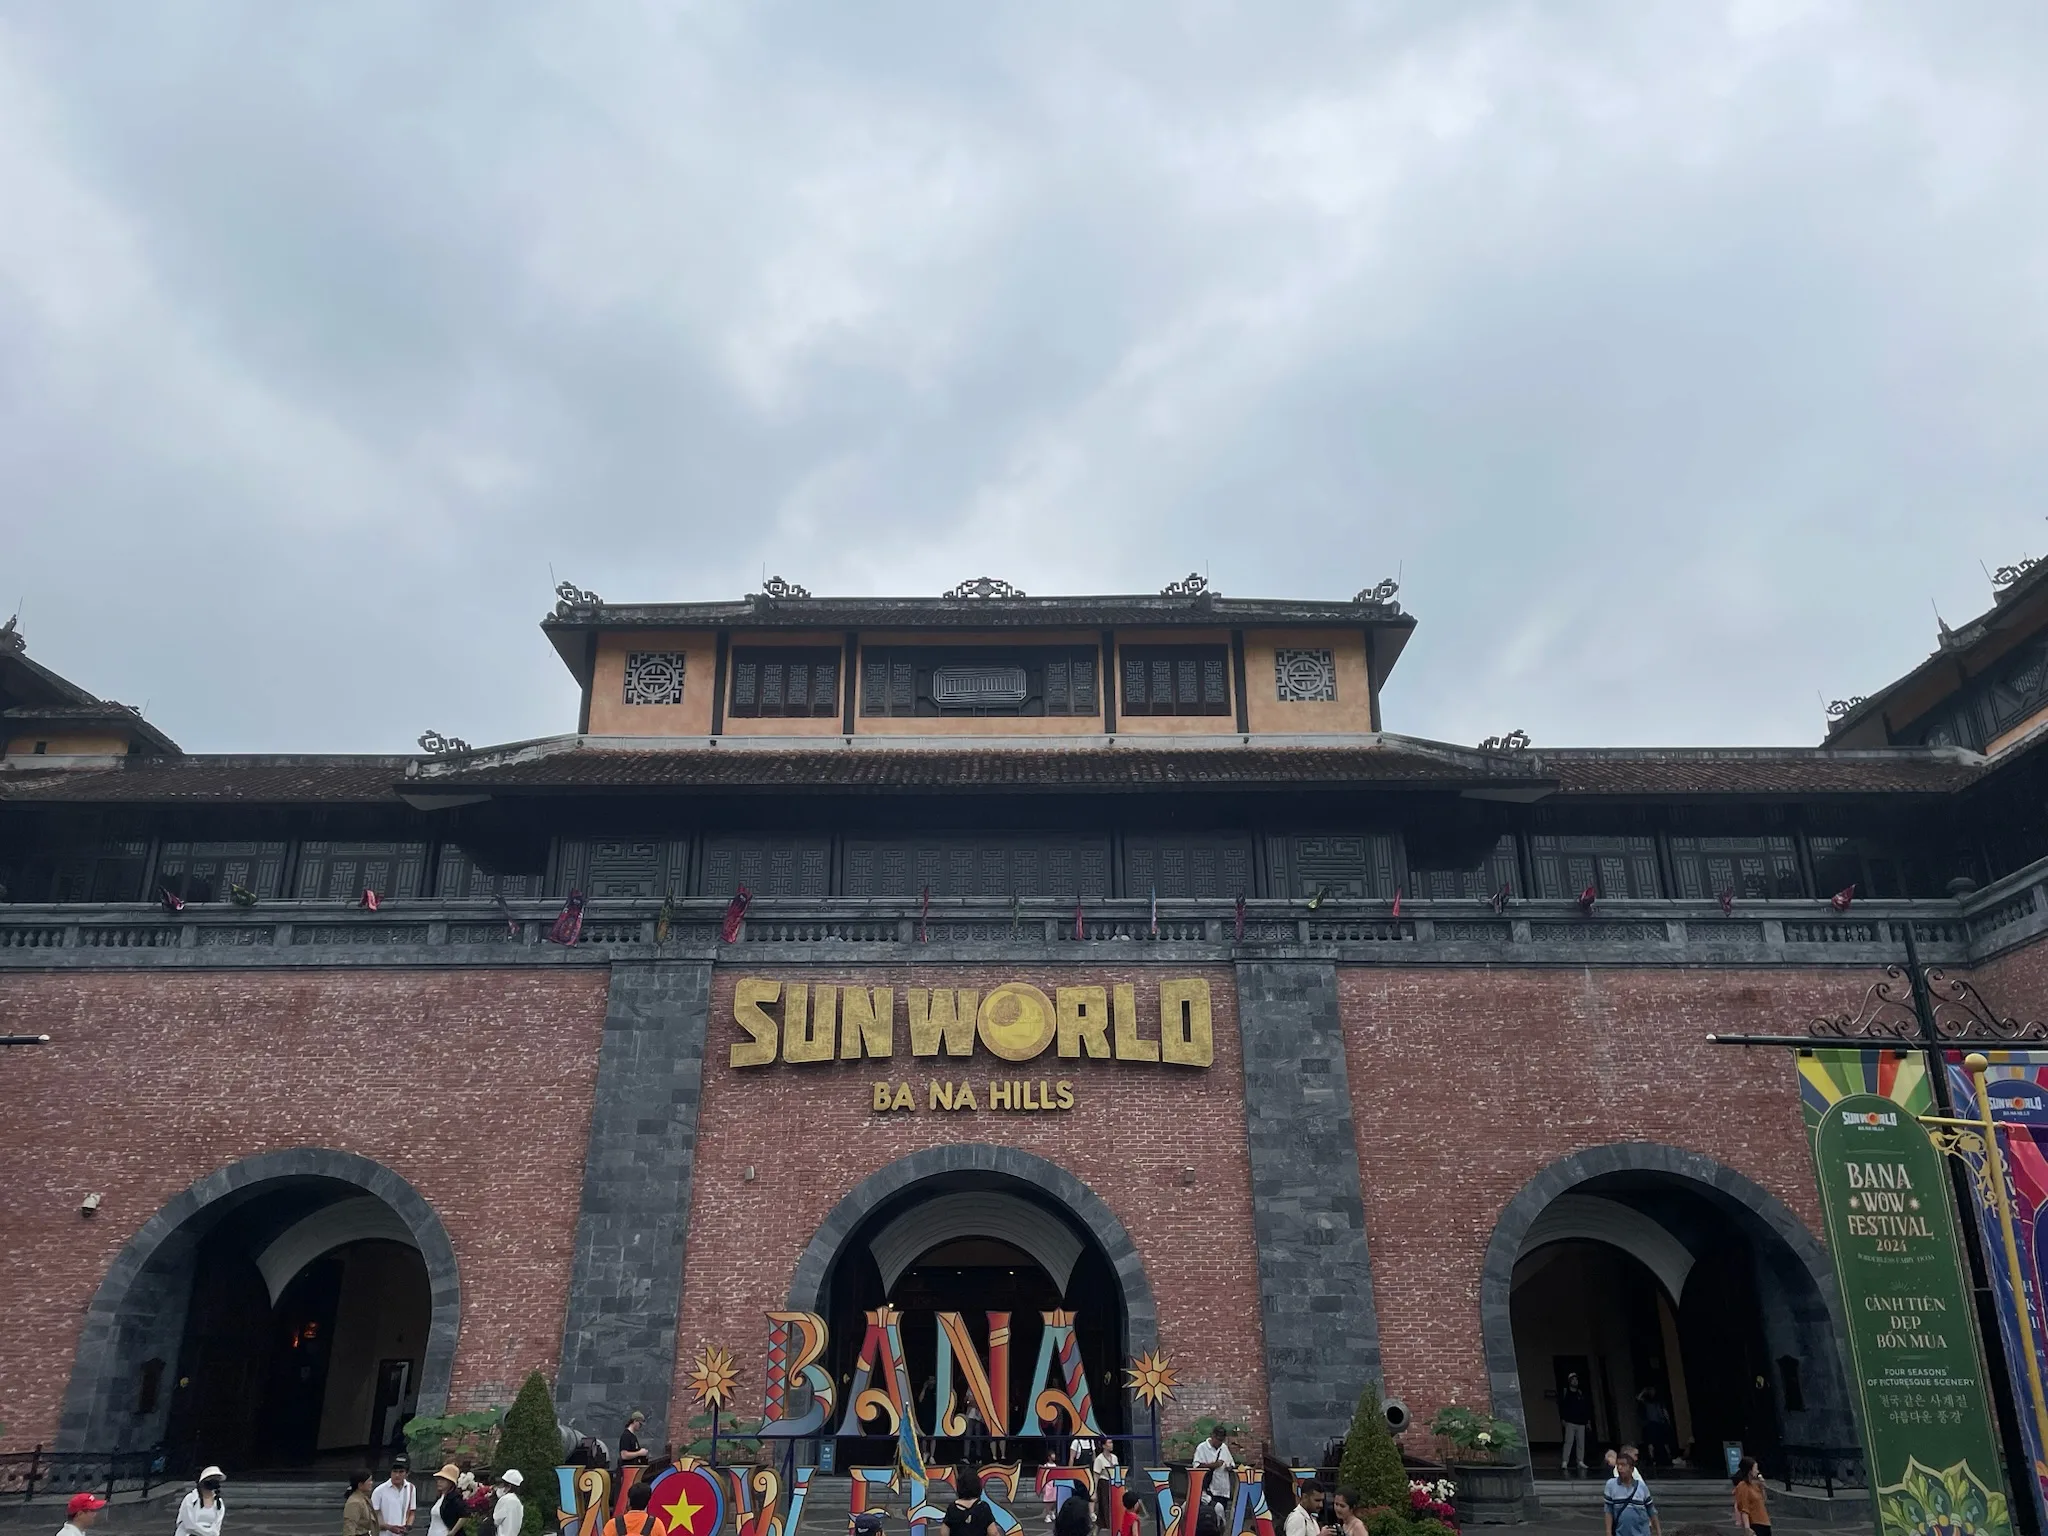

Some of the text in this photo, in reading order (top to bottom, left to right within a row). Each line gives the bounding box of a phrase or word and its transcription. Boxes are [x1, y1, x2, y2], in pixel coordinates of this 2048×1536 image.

[729, 977, 1214, 1069] SUN WORLD
[873, 1079, 1075, 1111] BA NA HILLS
[1845, 1162, 1912, 1190] BANA
[1861, 1192, 1905, 1213] WOW
[1847, 1214, 1934, 1237] FESTIVAL
[1876, 1239, 1908, 1253] 2024
[1890, 1316, 1921, 1331] ĐẸP
[757, 1305, 1104, 1437] BANA
[1885, 1368, 1947, 1376] FOUR SEASONS
[1890, 1410, 1932, 1424] 아름다운
